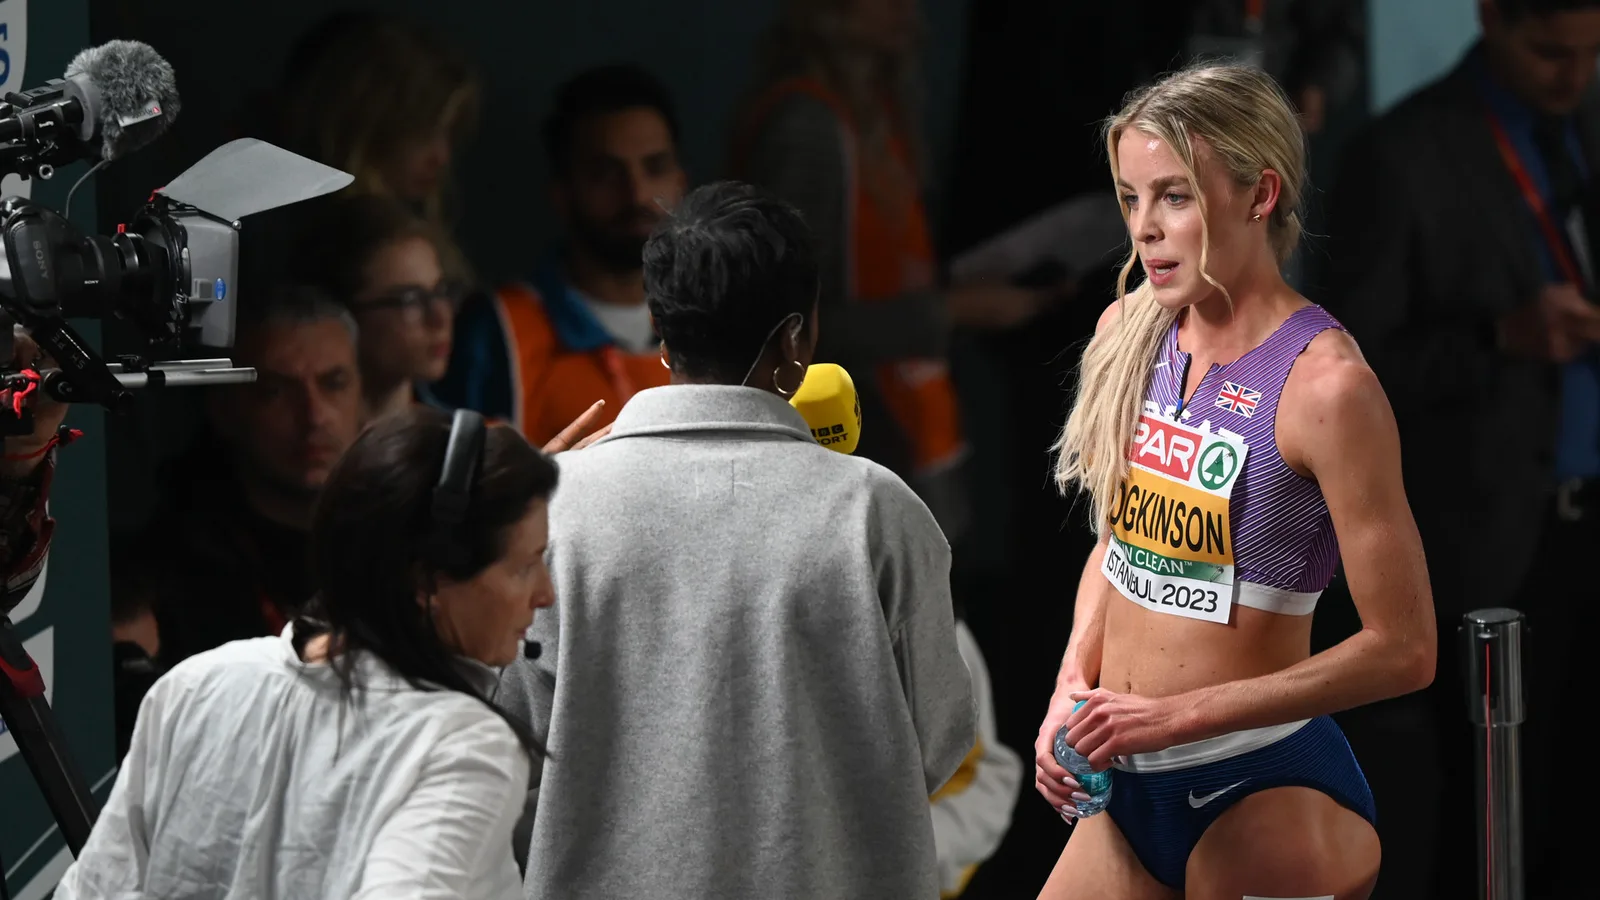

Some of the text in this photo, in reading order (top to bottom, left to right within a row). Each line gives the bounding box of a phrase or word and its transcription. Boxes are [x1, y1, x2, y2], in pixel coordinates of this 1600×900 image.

[33, 241, 48, 279] SONY
[811, 424, 844, 437] BC
[818, 433, 848, 445] ORT
[1134, 422, 1195, 473] PAR
[1110, 482, 1224, 555] DGKINSON
[1161, 583, 1218, 613] 2023
